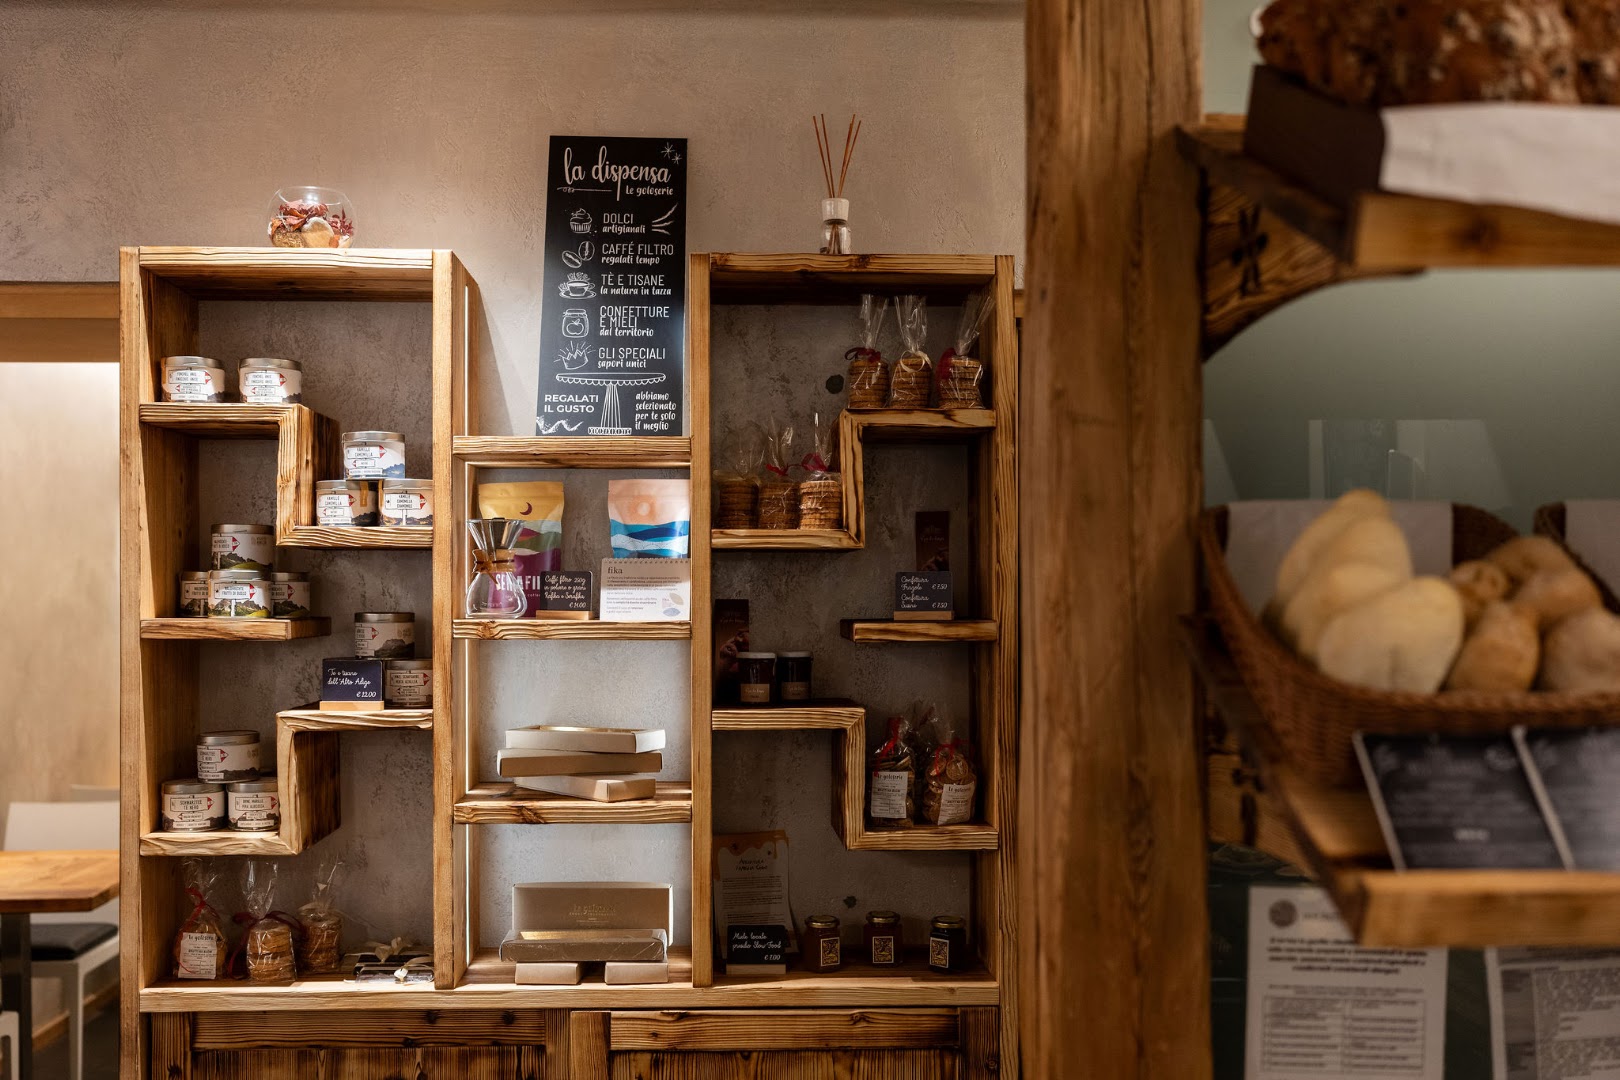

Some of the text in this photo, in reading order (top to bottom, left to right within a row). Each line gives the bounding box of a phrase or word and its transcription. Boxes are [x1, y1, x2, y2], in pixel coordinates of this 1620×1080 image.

[564, 145, 671, 201] la dispensa
[636, 186, 674, 197] goloserie
[603, 213, 634, 224] DOLCI
[602, 225, 646, 235] artigianali
[637, 244, 674, 255] FILTRO
[601, 255, 660, 266] regalati tempo
[601, 271, 665, 286] TÈ E TISANE
[600, 286, 672, 295] la natura in tazza
[600, 306, 670, 318] CONFETTURE
[600, 317, 637, 328] E MIELI
[600, 327, 654, 337] dal territorio
[598, 347, 666, 359] GLI SPECIALI
[598, 359, 647, 369] sapori unici
[544, 394, 599, 403] REGALATI
[635, 391, 669, 400] abbiamo
[544, 405, 595, 413] IL GUSTO
[635, 401, 677, 411] selezionato
[635, 412, 676, 421] per te solo
[635, 422, 669, 432] il meglio
[607, 566, 623, 574] fika
